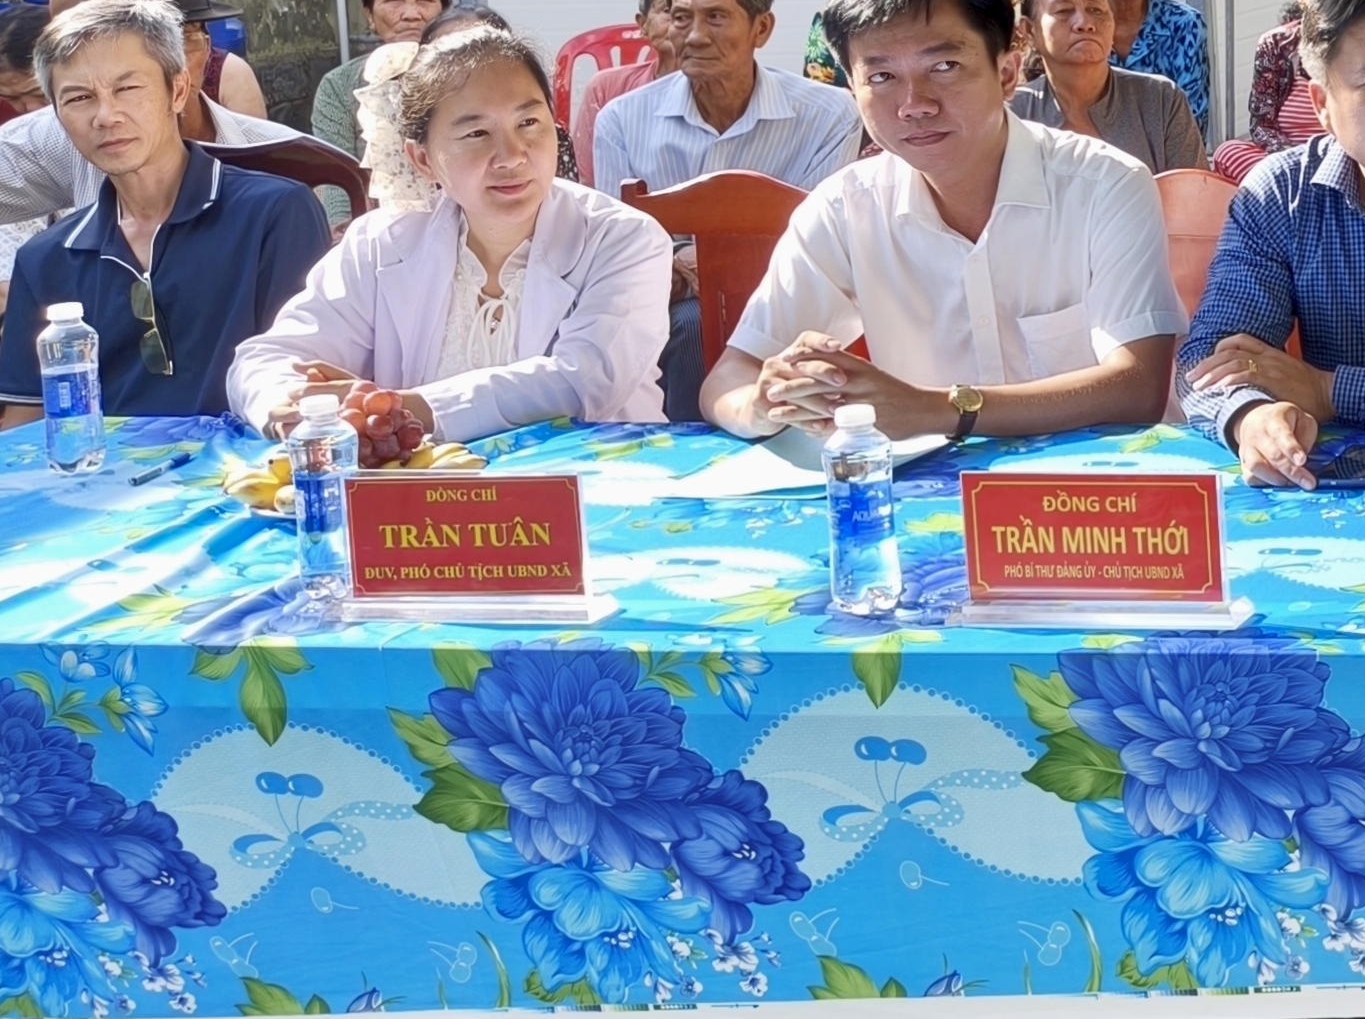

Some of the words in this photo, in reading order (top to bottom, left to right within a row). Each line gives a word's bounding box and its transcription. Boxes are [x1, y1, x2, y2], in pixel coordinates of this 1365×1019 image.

[471, 485, 497, 501] CHÍ
[1042, 490, 1100, 513] ĐỒNG
[1105, 492, 1137, 513] CHÍ
[379, 517, 461, 548] TRẦN
[991, 515, 1055, 554] TRẦN
[1061, 526, 1127, 554] MINH
[1132, 520, 1189, 555] THỚI
[365, 567, 398, 581] ĐUV,
[401, 564, 431, 579] PHÓ
[434, 563, 465, 579] CHỦ
[468, 564, 504, 581] TỊCH
[507, 564, 548, 578] UBND
[551, 562, 572, 577] XÃ
[1004, 561, 1023, 578] PHÓ
[1025, 561, 1034, 578] BÍ
[1035, 564, 1056, 578] THƯ
[1057, 560, 1083, 578] ĐẢNG
[1084, 560, 1096, 578] ỦY
[1103, 561, 1121, 579] CHỦ
[1123, 565, 1143, 581] TỊCH
[1144, 565, 1170, 579] UBND
[1171, 563, 1185, 579] XÃ
